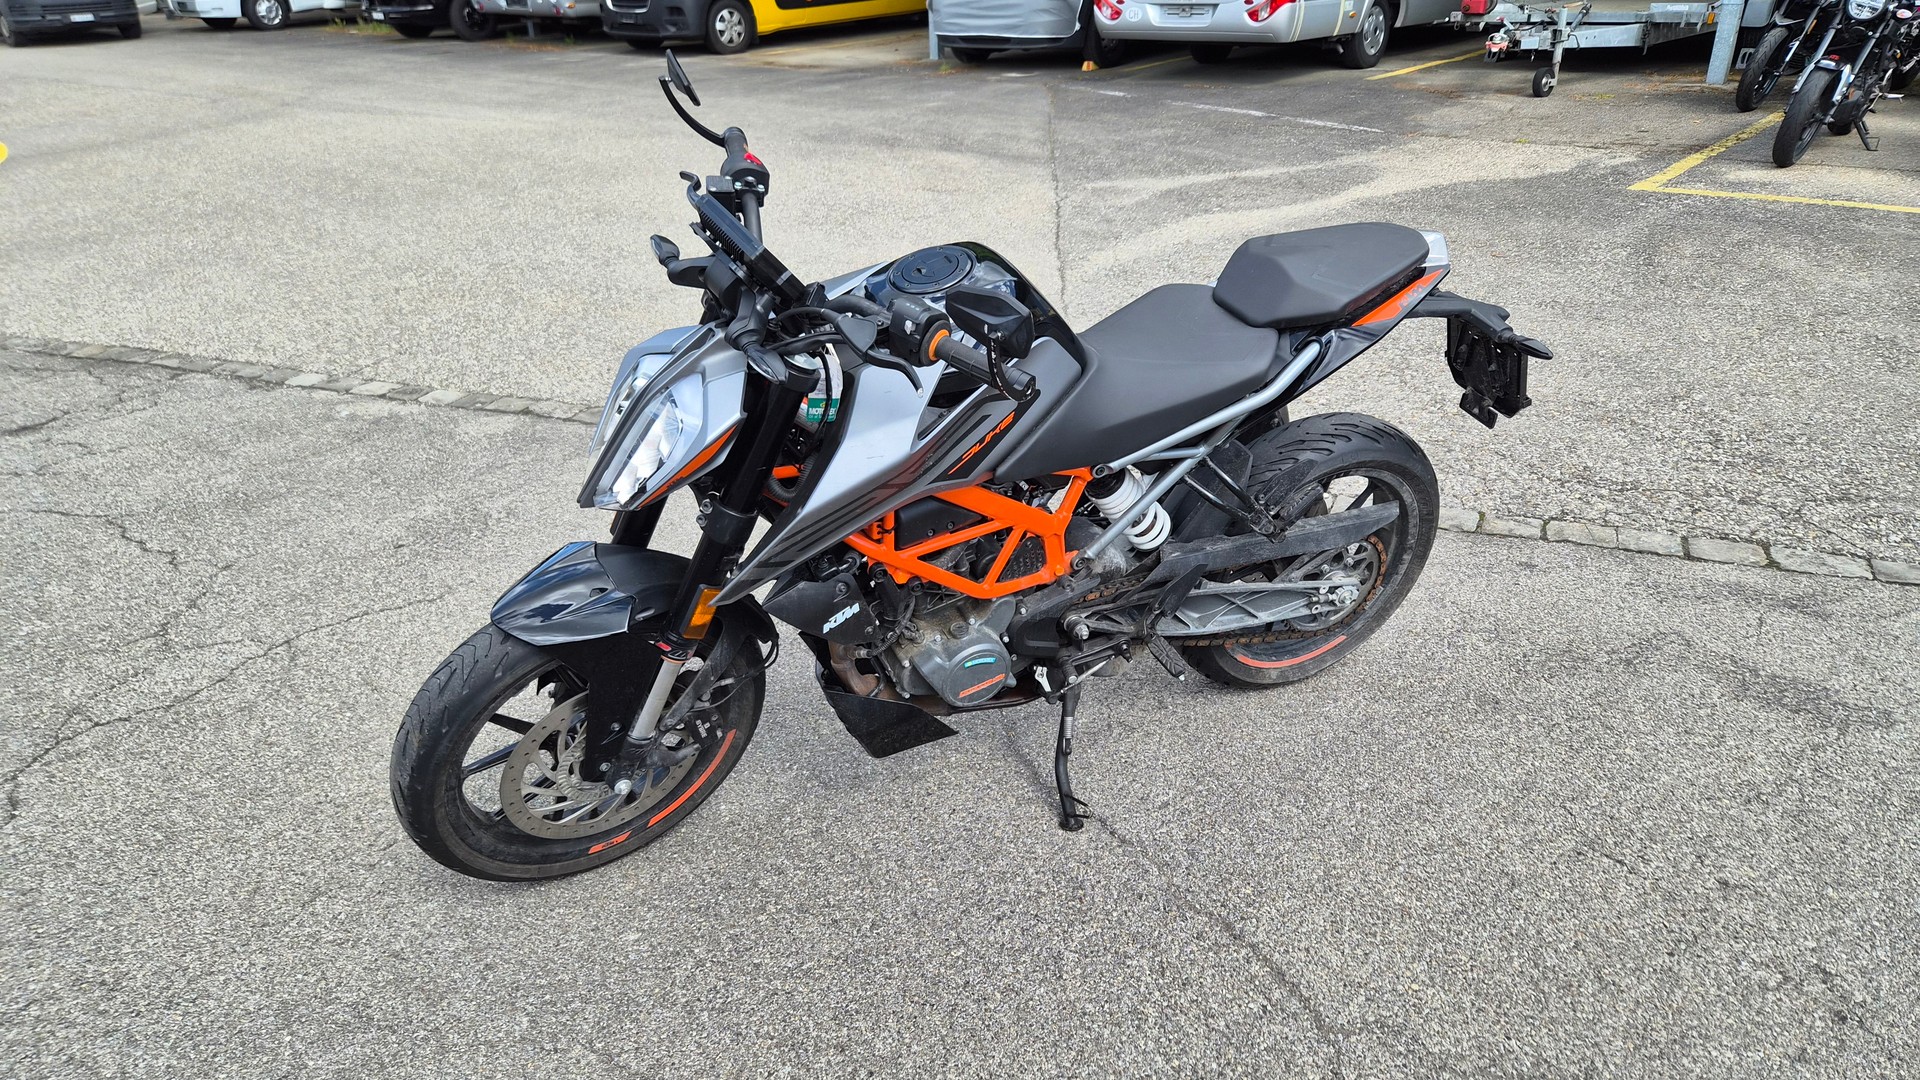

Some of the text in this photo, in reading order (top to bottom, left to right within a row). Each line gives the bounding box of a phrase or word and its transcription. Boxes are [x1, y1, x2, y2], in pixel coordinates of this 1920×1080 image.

[1128, 8, 1139, 19] CH
[808, 407, 837, 415] MOTOEX
[948, 411, 1015, 475] DUKE
[822, 602, 860, 634] KTM
